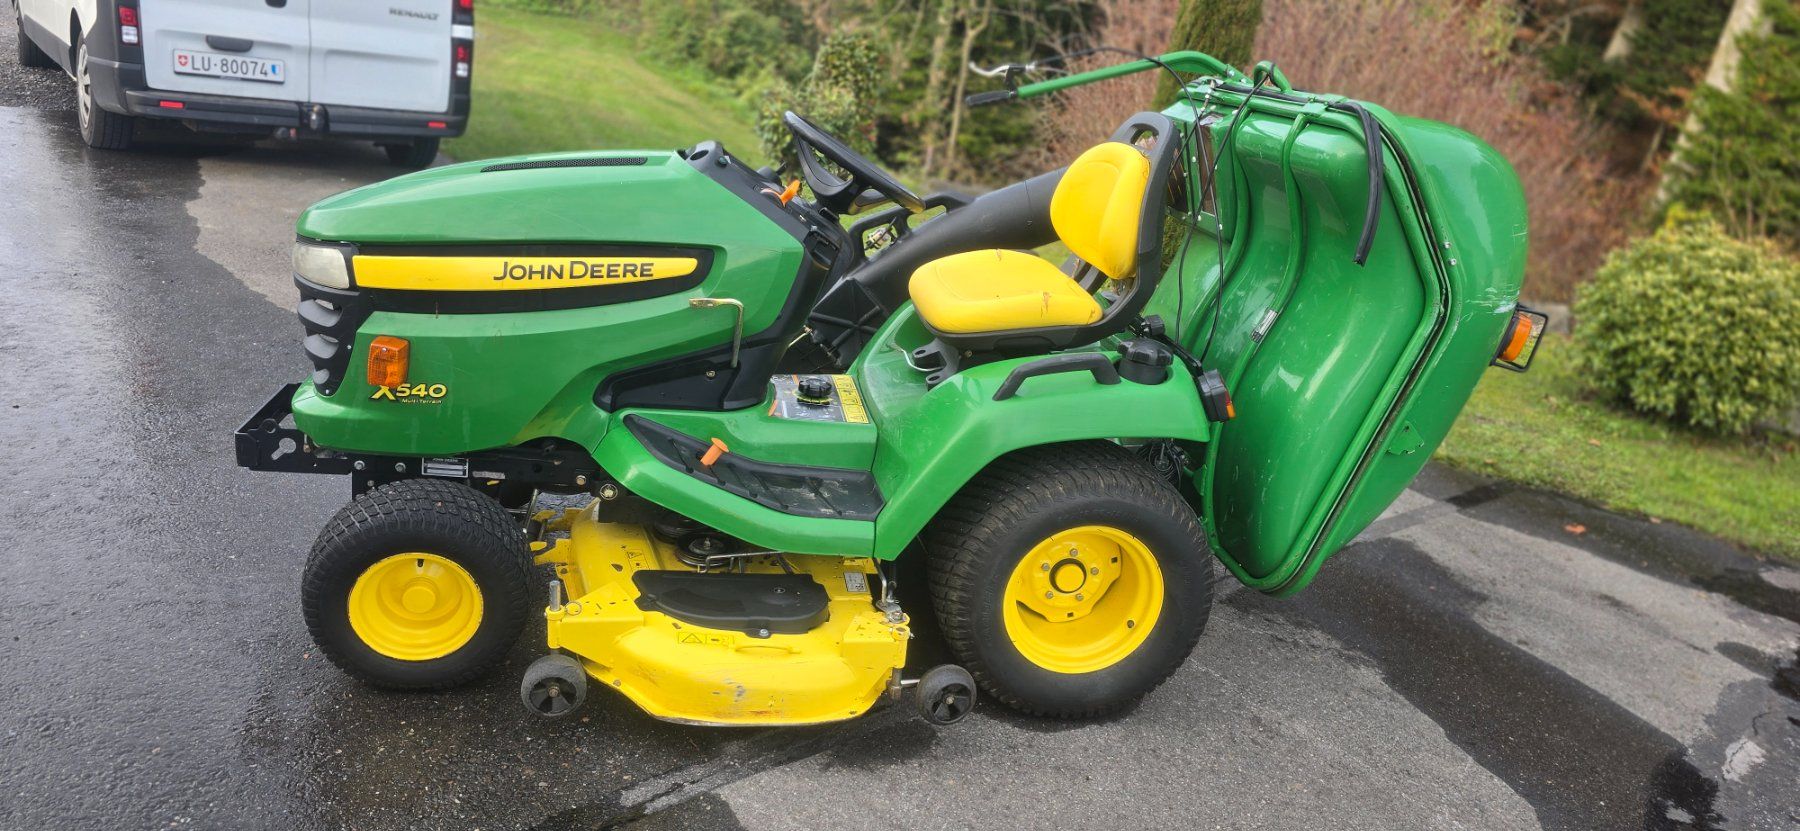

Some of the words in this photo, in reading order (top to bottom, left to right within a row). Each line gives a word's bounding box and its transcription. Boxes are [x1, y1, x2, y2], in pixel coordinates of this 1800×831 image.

[493, 261, 564, 281] JOHN
[569, 260, 654, 279] DEERE
[370, 383, 447, 401] X540
